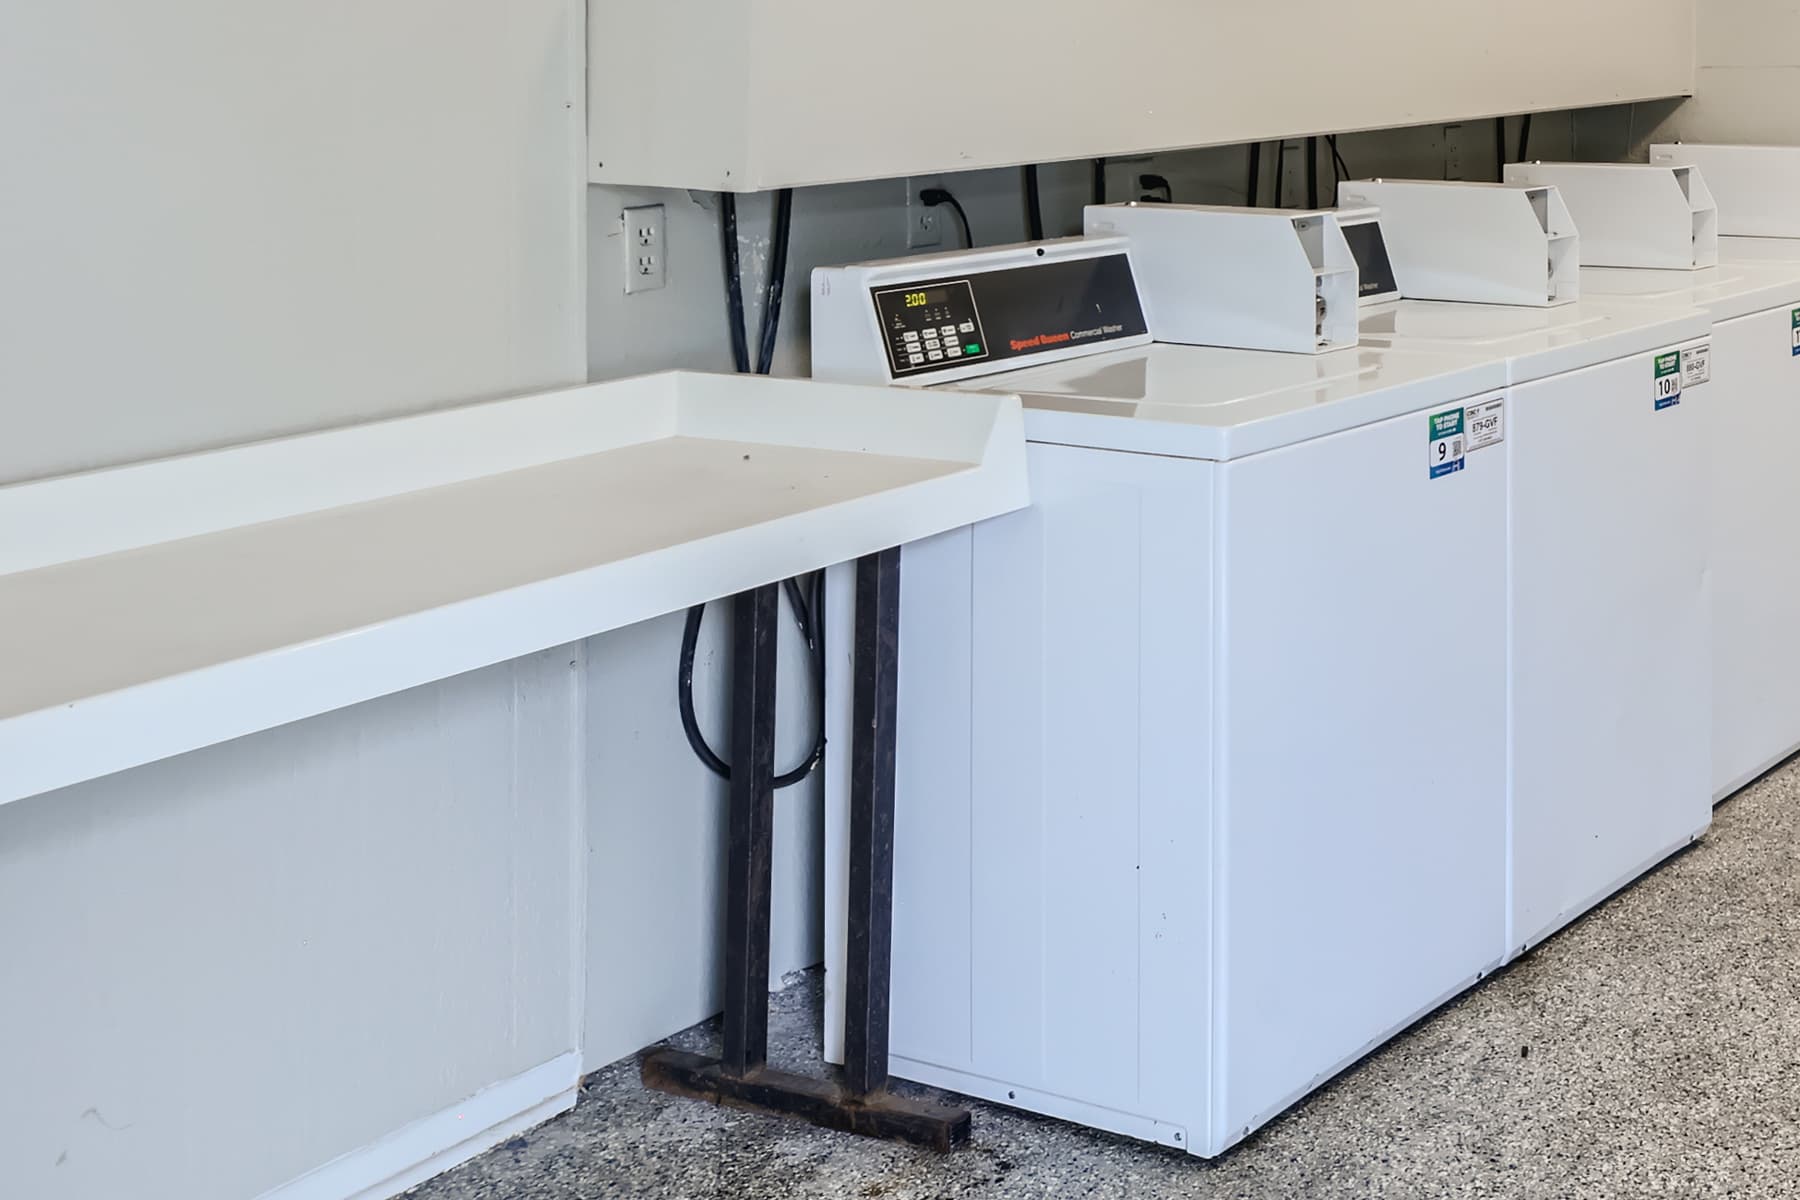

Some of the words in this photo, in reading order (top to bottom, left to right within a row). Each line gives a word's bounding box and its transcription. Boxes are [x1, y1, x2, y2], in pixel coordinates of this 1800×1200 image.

[1010, 335, 1039, 351] Speed
[1658, 378, 1671, 397] 10
[1438, 442, 1446, 461] 9
